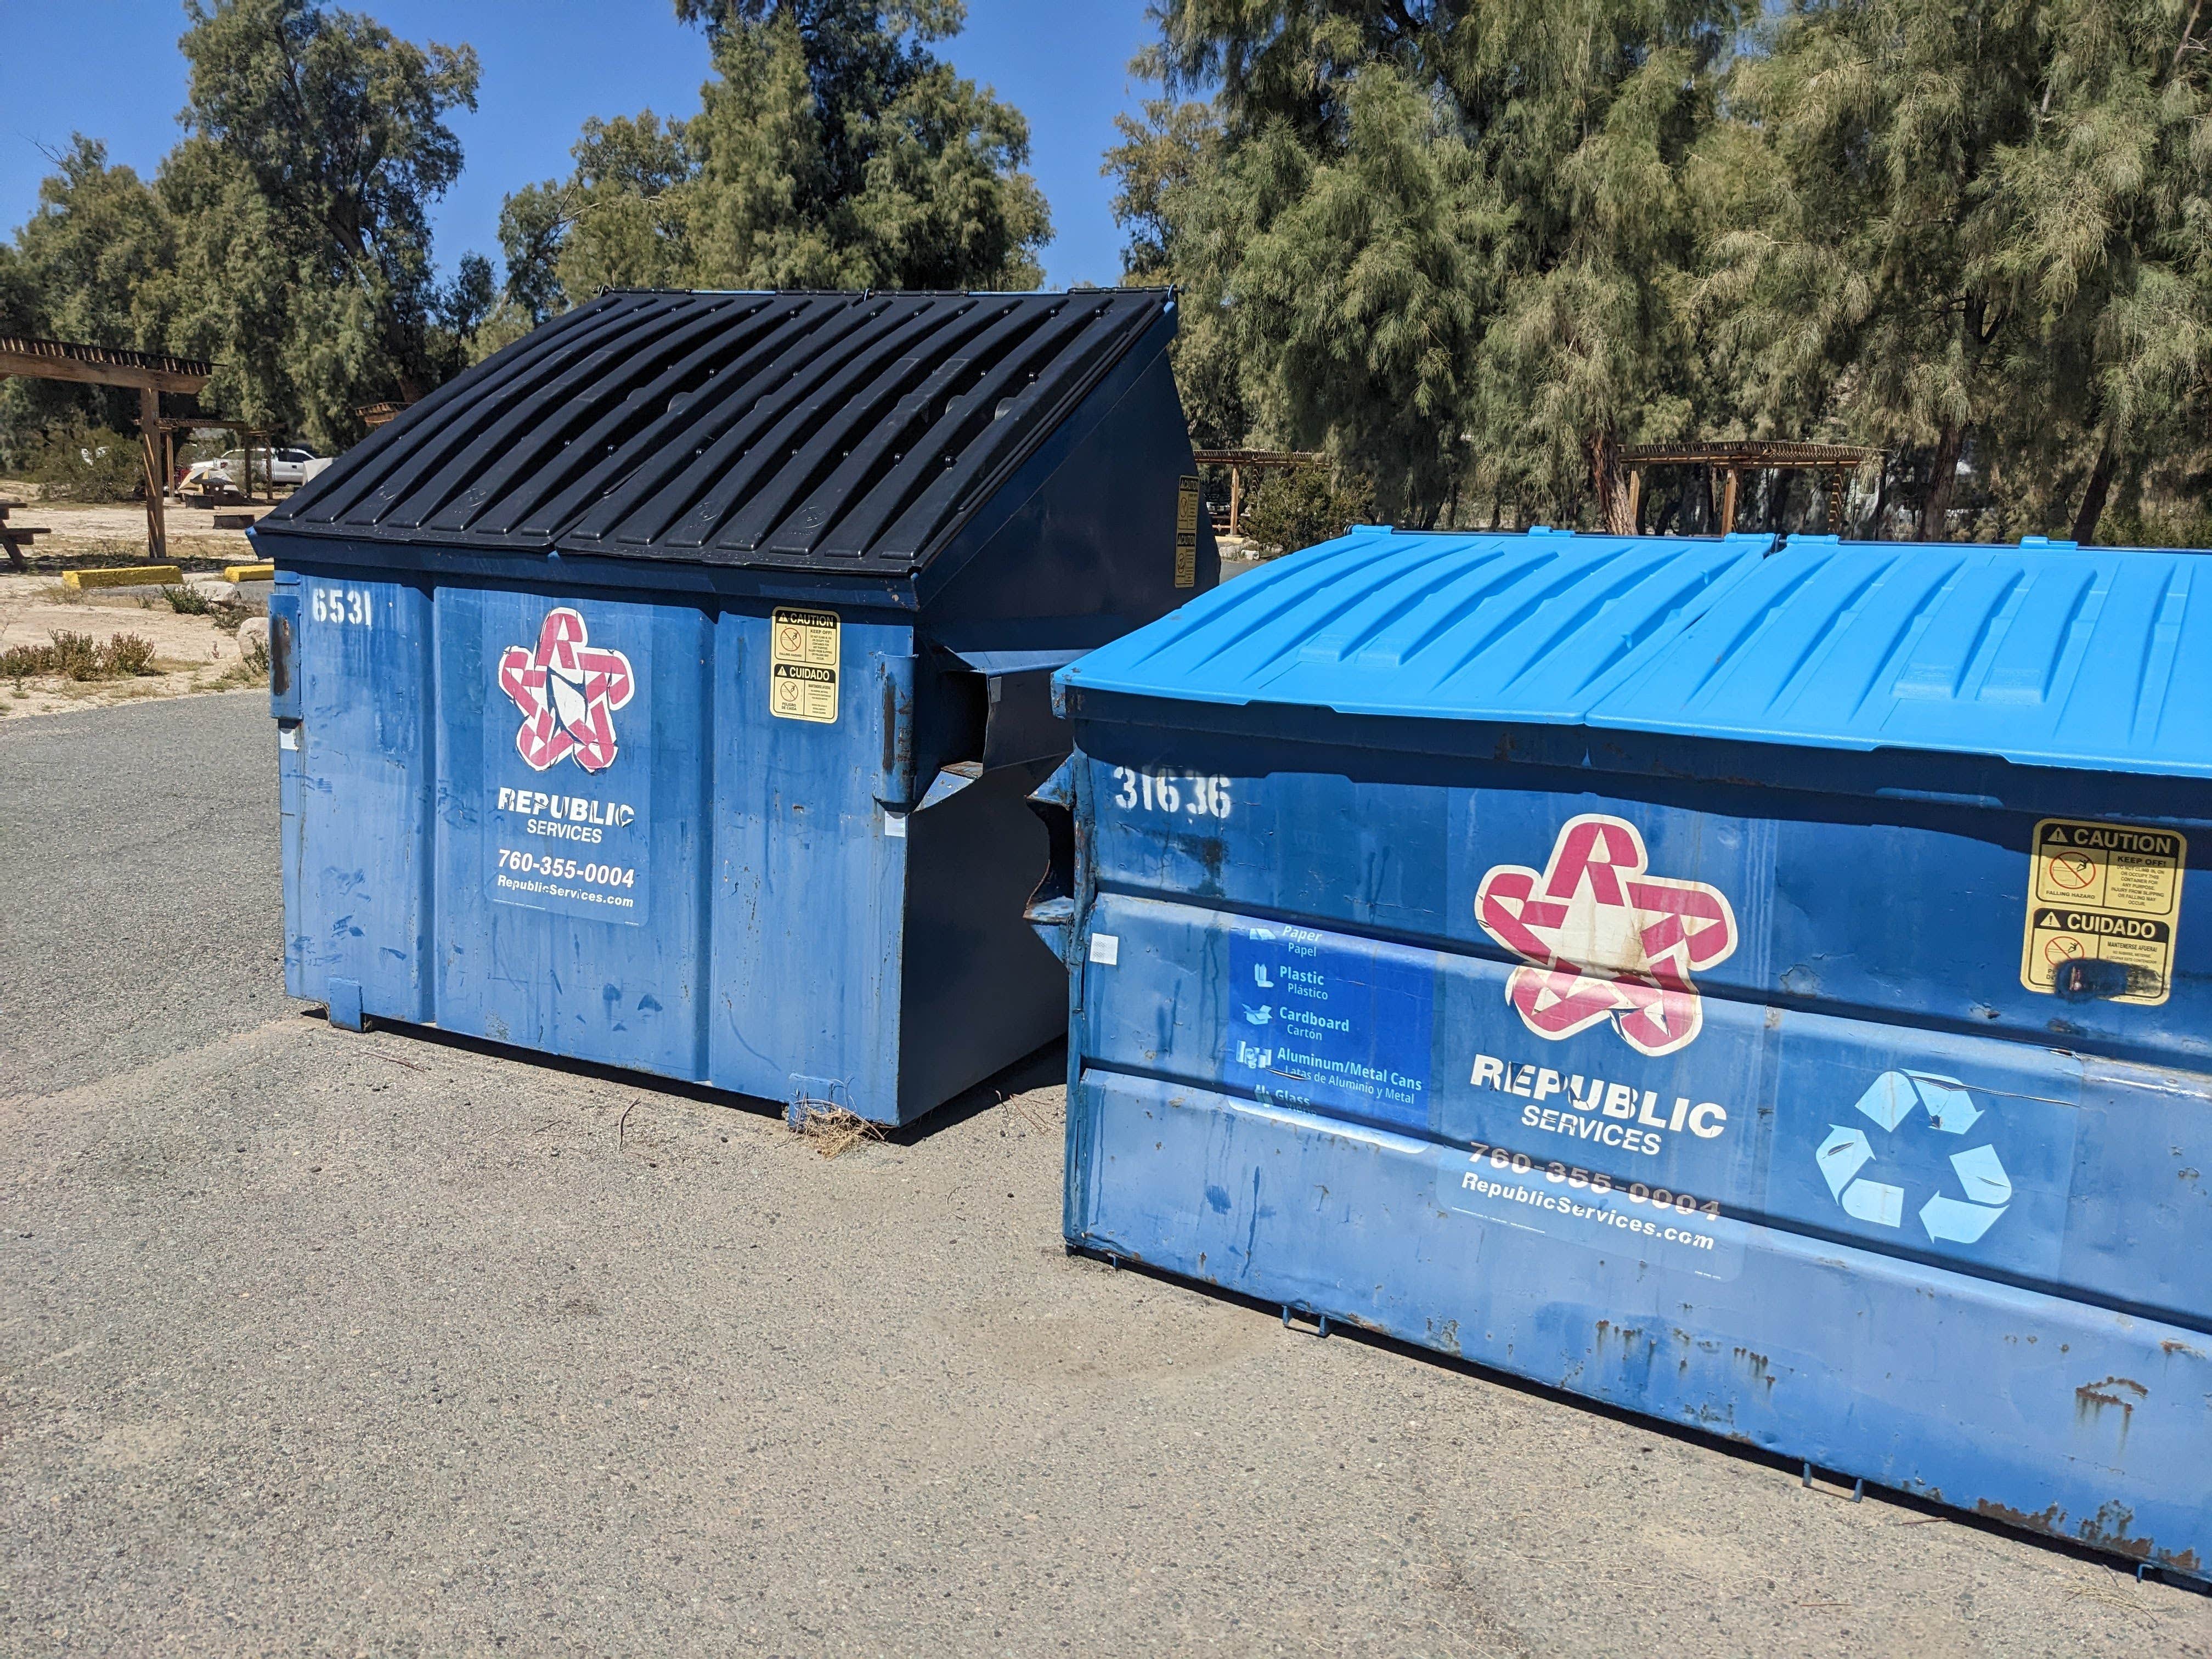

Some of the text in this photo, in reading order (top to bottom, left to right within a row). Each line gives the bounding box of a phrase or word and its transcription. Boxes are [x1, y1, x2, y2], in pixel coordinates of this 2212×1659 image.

[312, 588, 372, 629] 6531
[790, 613, 833, 627] CAUTION
[789, 667, 830, 681] CUIDADO
[1114, 766, 1231, 819] 31636
[498, 787, 635, 828] REPUBLIC
[527, 819, 602, 843] SERVICES
[2074, 829, 2171, 854] CAUTION
[498, 849, 634, 888] 760-355-0004
[2145, 859, 2166, 867] OFF!
[498, 874, 634, 907] RepublicServices.com
[1282, 925, 1323, 943] Paper
[2067, 914, 2155, 938] CUIDADO
[1288, 942, 1317, 957] Papel
[1280, 965, 1324, 986] Plastic
[1288, 983, 1328, 1000] Plástico
[1279, 1006, 1350, 1032] Cardboard
[1287, 1024, 1322, 1041] Cartón
[1277, 1047, 1422, 1091] Aluminum/Metal Cans
[1276, 1089, 1310, 1106] Glass
[1314, 1071, 1326, 1084] de
[1328, 1075, 1374, 1095] Aluminio
[1376, 1086, 1384, 1098] y
[1385, 1085, 1414, 1104] Metal
[1470, 1054, 1726, 1138] REPUBLIC
[1521, 1105, 1662, 1155] SERVICES
[1469, 1141, 1721, 1221] 760-355-0004
[1462, 1171, 1714, 1250] RepublicServices.com
